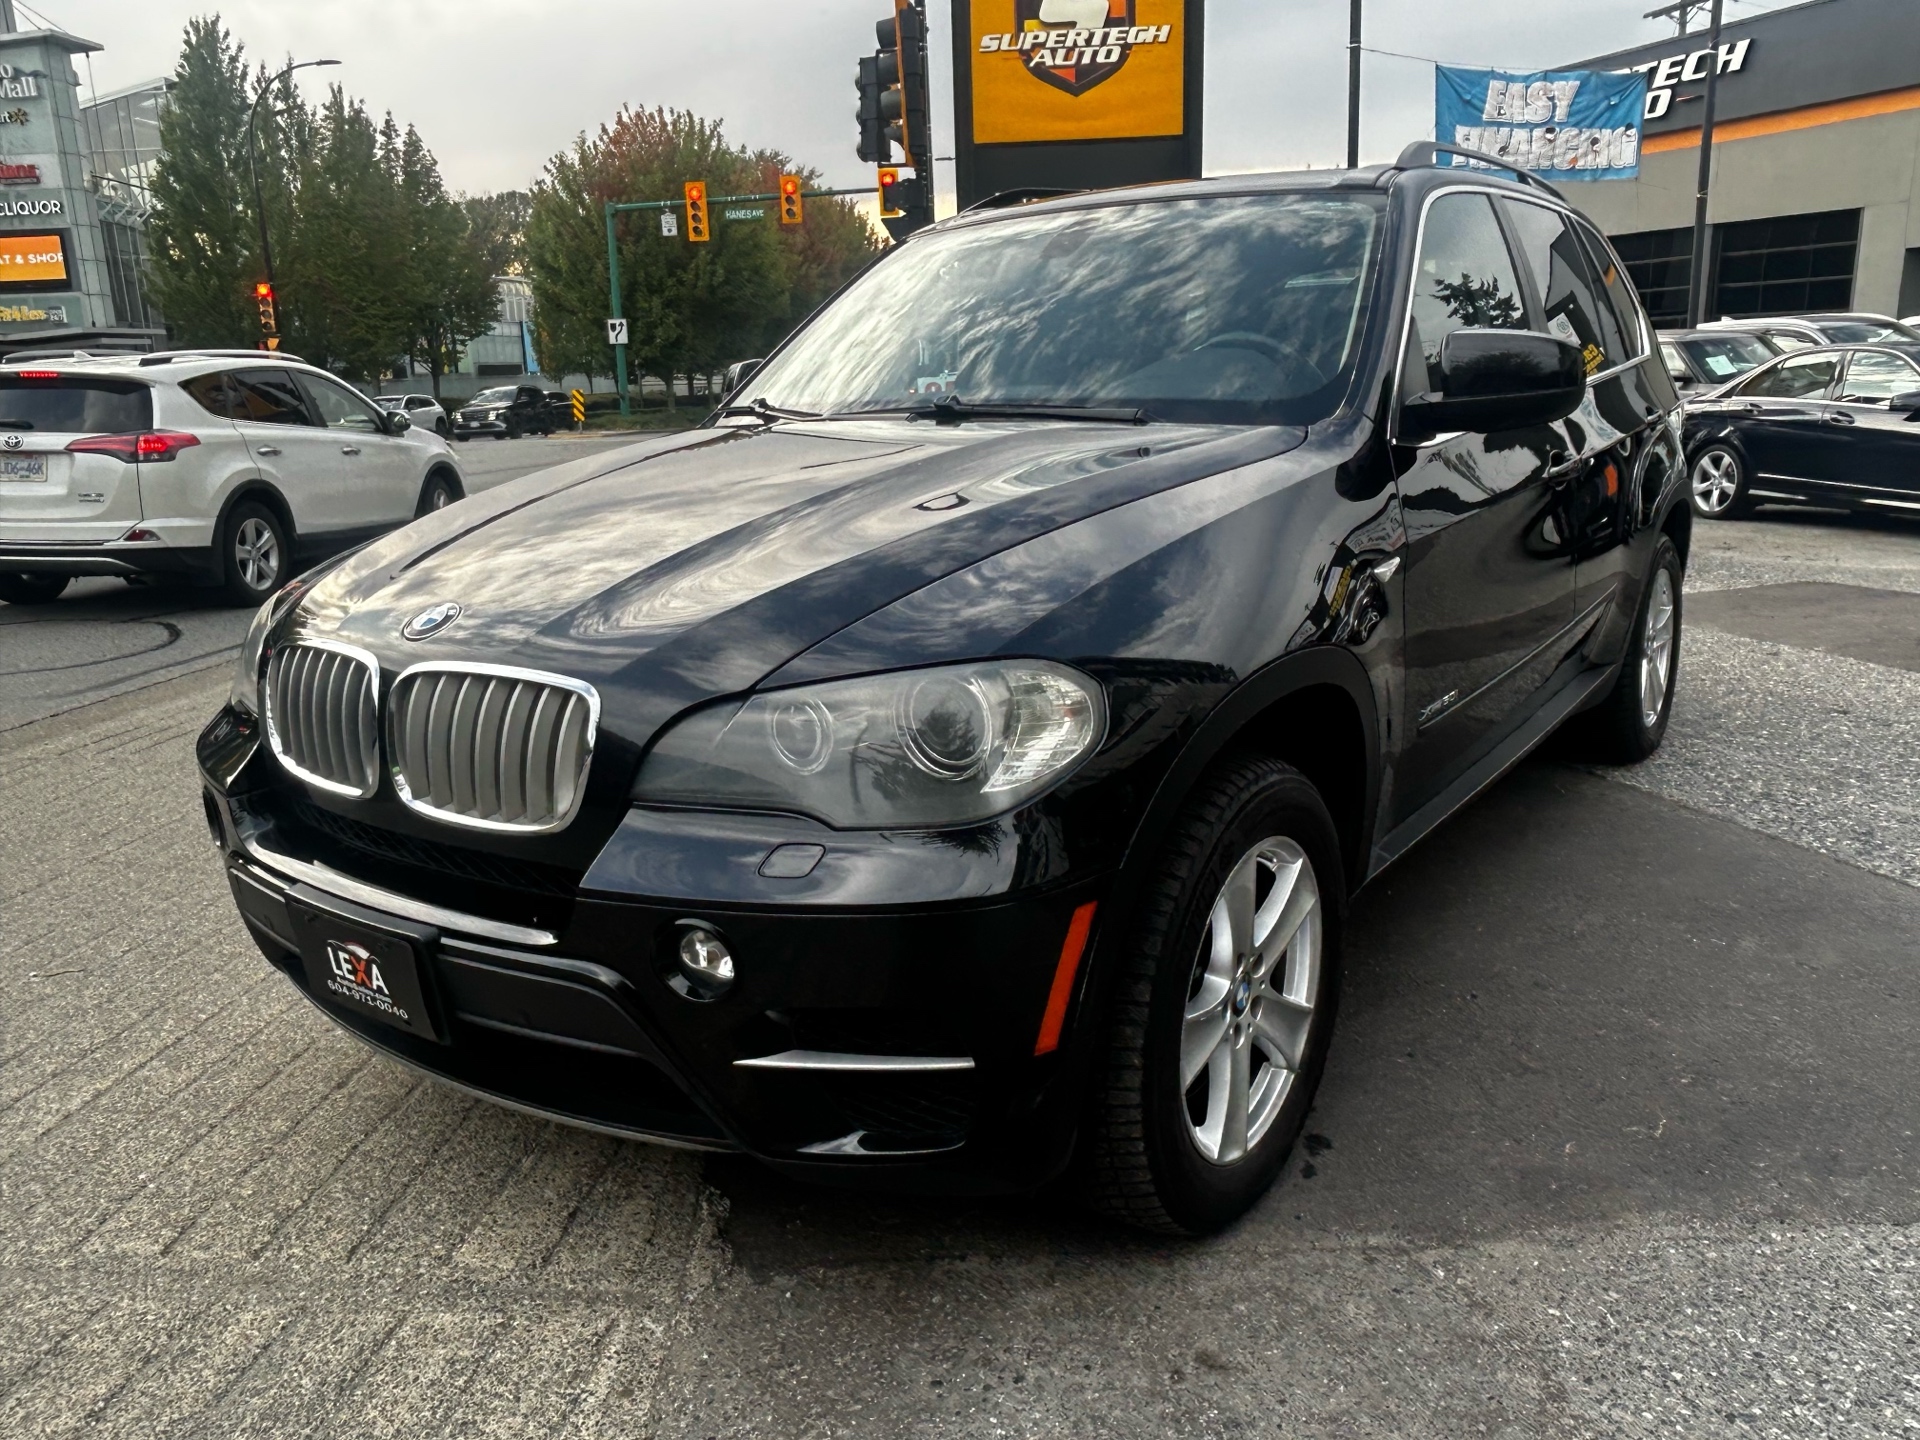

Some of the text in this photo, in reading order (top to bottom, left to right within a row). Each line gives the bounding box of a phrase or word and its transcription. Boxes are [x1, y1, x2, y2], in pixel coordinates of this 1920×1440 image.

[979, 25, 1171, 52] SUPERTECH
[1028, 45, 1121, 67] AUTO
[1483, 80, 1580, 123] EASY
[725, 209, 752, 219] HANES
[327, 946, 389, 995] LEXA
[327, 979, 409, 1019] 604-971-0040
